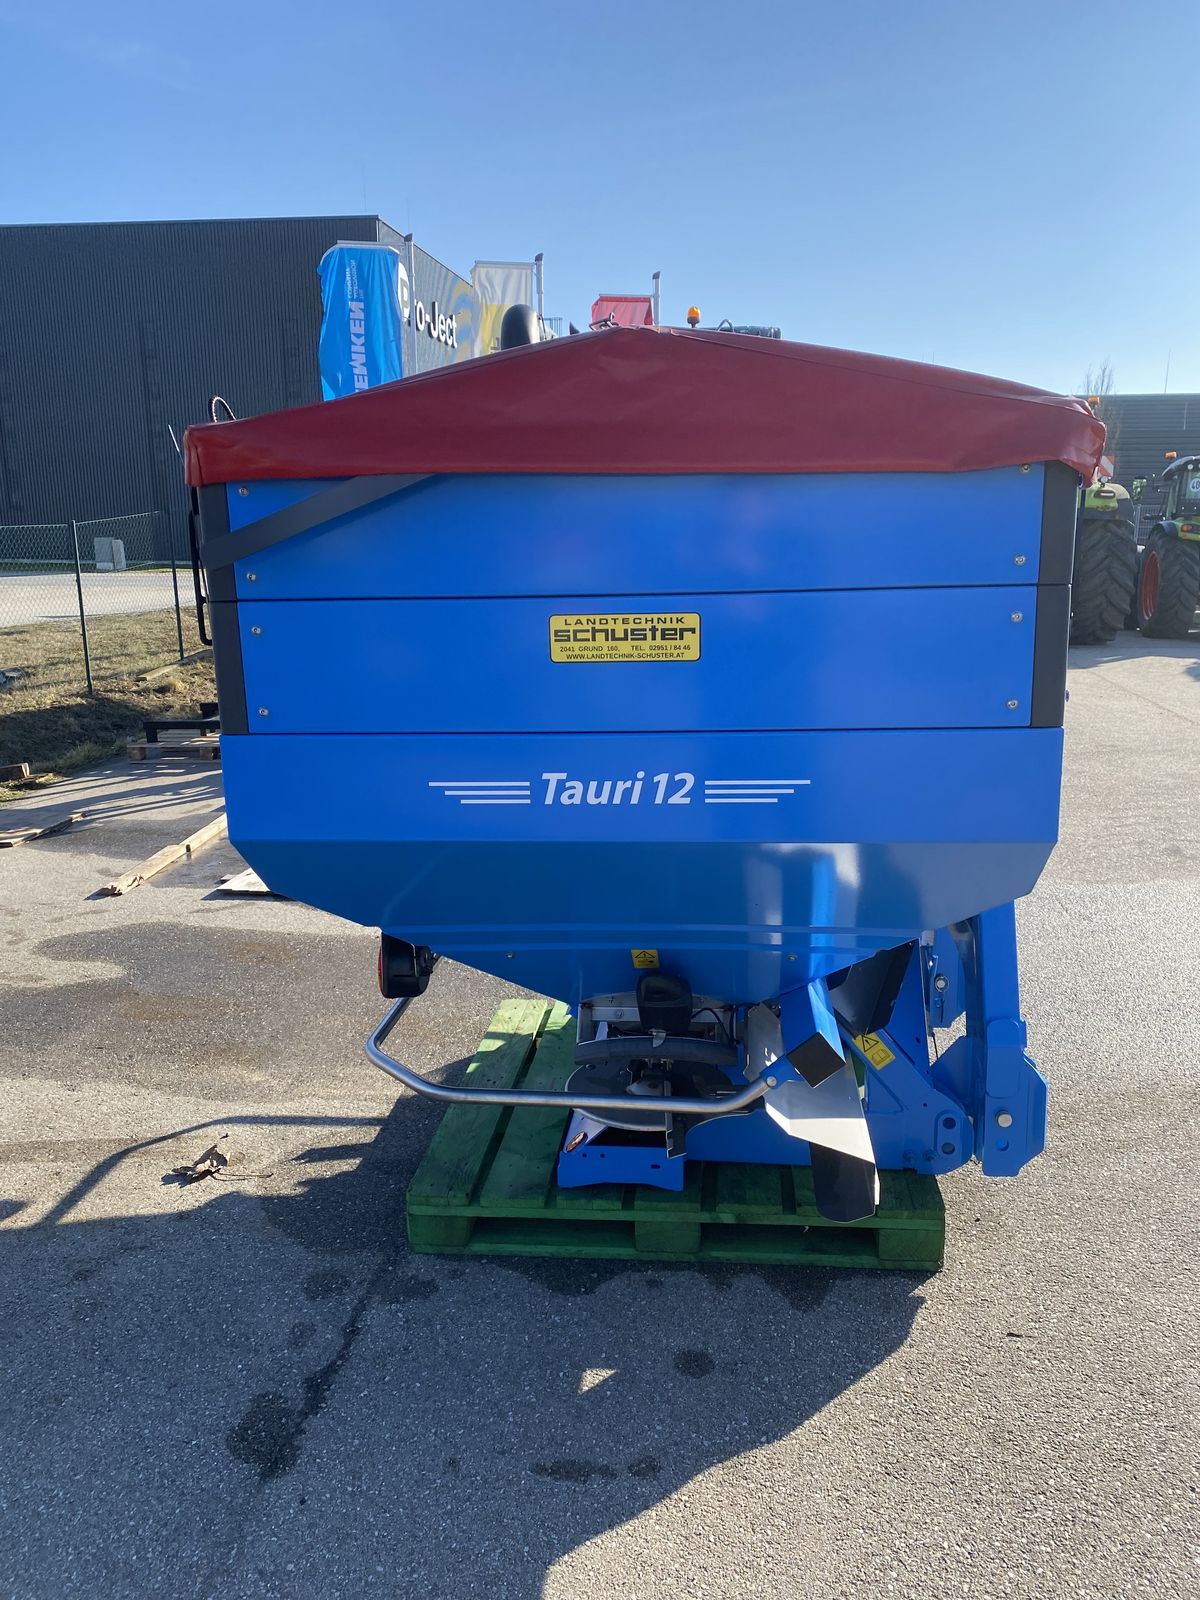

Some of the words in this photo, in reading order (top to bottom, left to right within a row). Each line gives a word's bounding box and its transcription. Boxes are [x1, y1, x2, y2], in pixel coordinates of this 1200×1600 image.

[564, 617, 685, 626] LANDTECHNIK
[554, 625, 696, 642] schuster
[566, 652, 685, 660] WWW.LANDTECHNIK-SCHUSTER.AT
[541, 771, 645, 805] Tauri
[652, 772, 695, 805] 12
